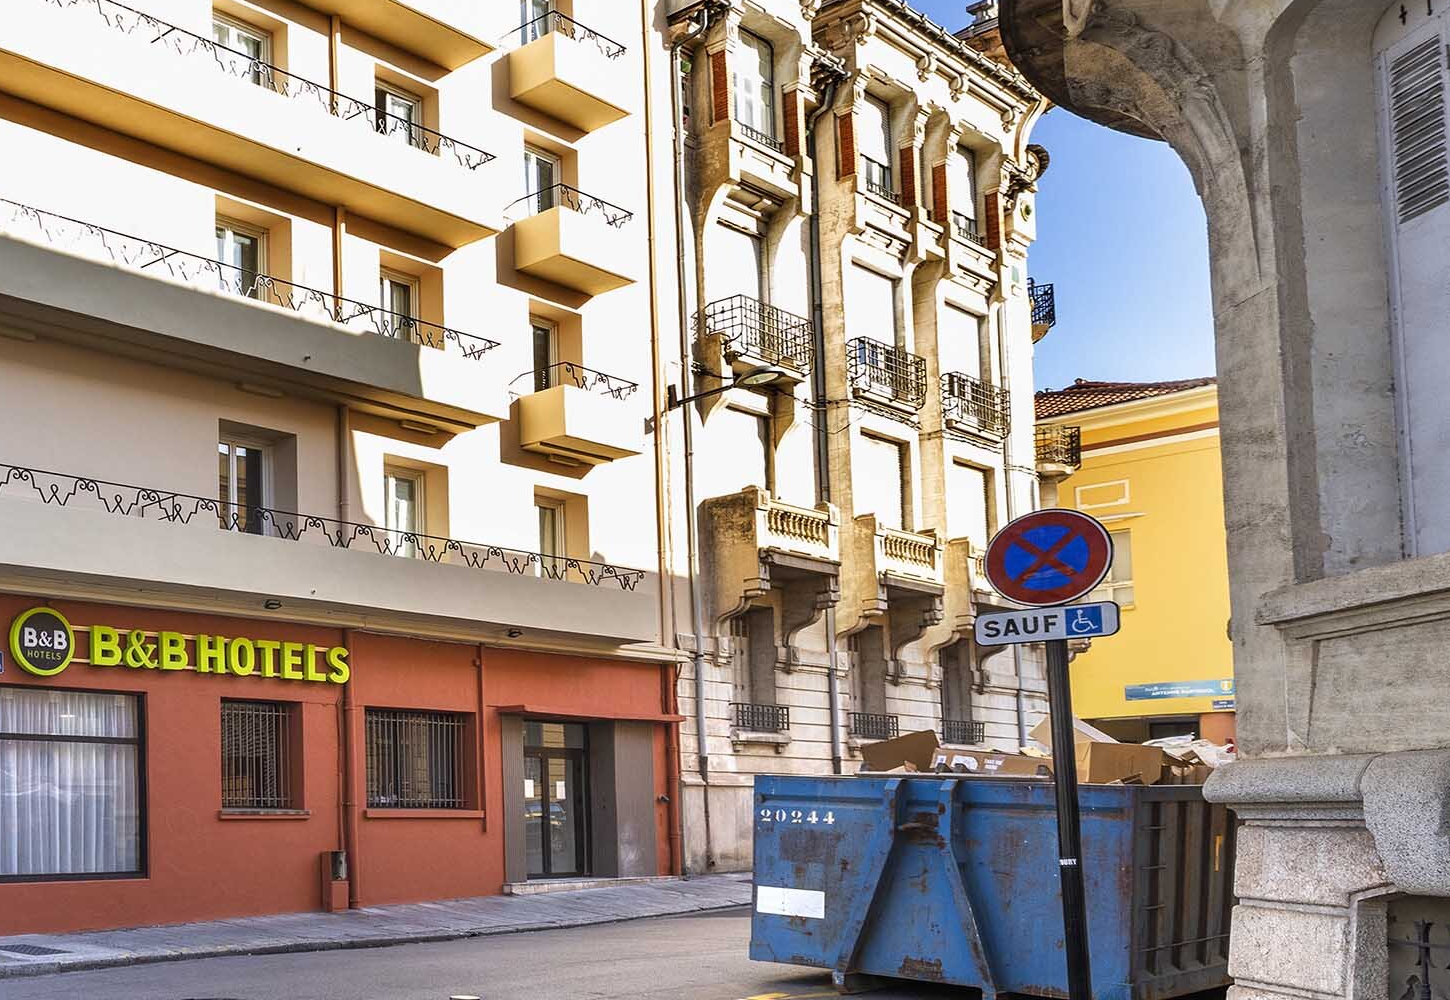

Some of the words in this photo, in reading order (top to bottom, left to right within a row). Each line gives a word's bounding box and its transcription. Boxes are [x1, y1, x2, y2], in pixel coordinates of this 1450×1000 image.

[983, 614, 1058, 639] SAUF
[23, 627, 68, 650] B&B
[27, 650, 62, 660] HOTELS
[90, 625, 189, 670] B&B
[196, 634, 350, 684] HOTELS
[760, 808, 836, 825] 20244
